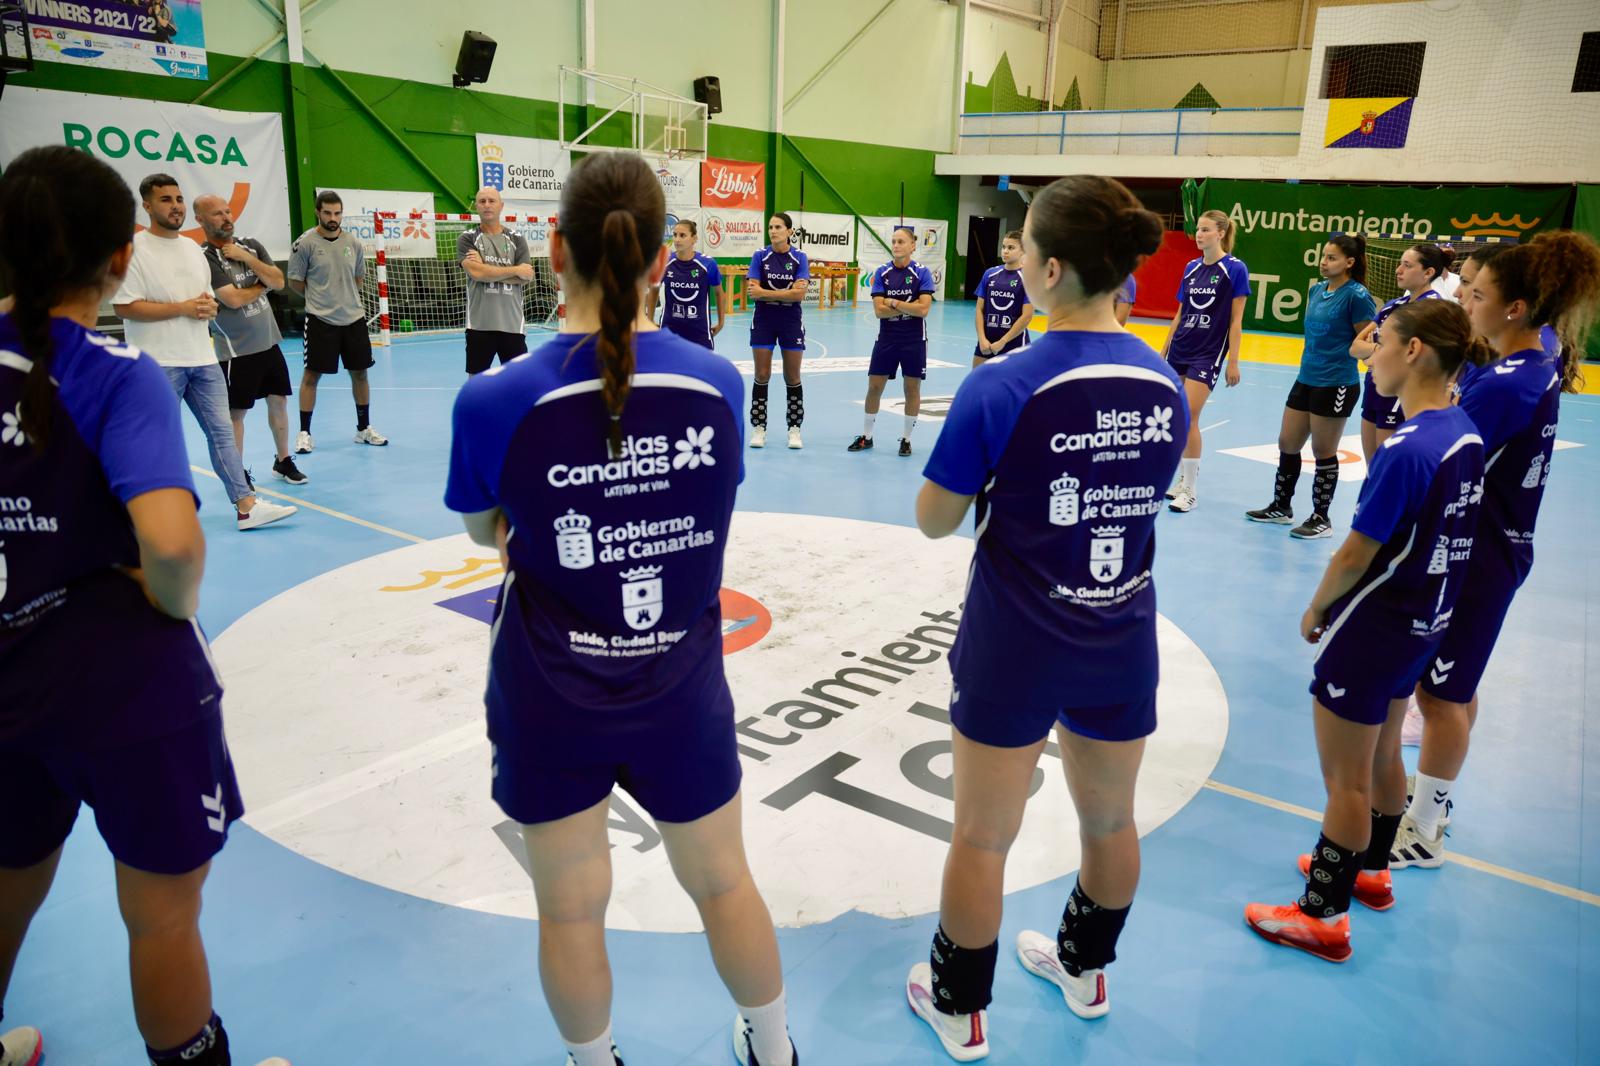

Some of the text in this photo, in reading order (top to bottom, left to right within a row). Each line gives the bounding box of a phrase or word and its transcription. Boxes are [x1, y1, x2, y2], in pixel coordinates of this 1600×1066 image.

[63, 122, 248, 167] ROCASA
[508, 164, 555, 178] Gobierno
[507, 177, 521, 189] de
[705, 166, 757, 200] Libby's
[1229, 202, 1433, 236] Ayuntamiento
[802, 228, 850, 246] hummel
[670, 281, 700, 290] ROCASA
[767, 272, 794, 281] ROCASA
[887, 288, 913, 296] ROCASA
[990, 289, 1016, 299] ROCASA
[1189, 287, 1217, 295] ROCASA
[1096, 408, 1142, 430] Islas
[1050, 427, 1142, 453] Canarias
[547, 454, 671, 488] Canarias
[1083, 484, 1155, 504] Gobierno
[1081, 504, 1099, 520] de
[0, 512, 59, 533] arias
[597, 515, 696, 544] Gobierno
[599, 529, 715, 563] de Canarias
[1075, 585, 1115, 599] Ciudad
[610, 631, 655, 648] Ciudad
